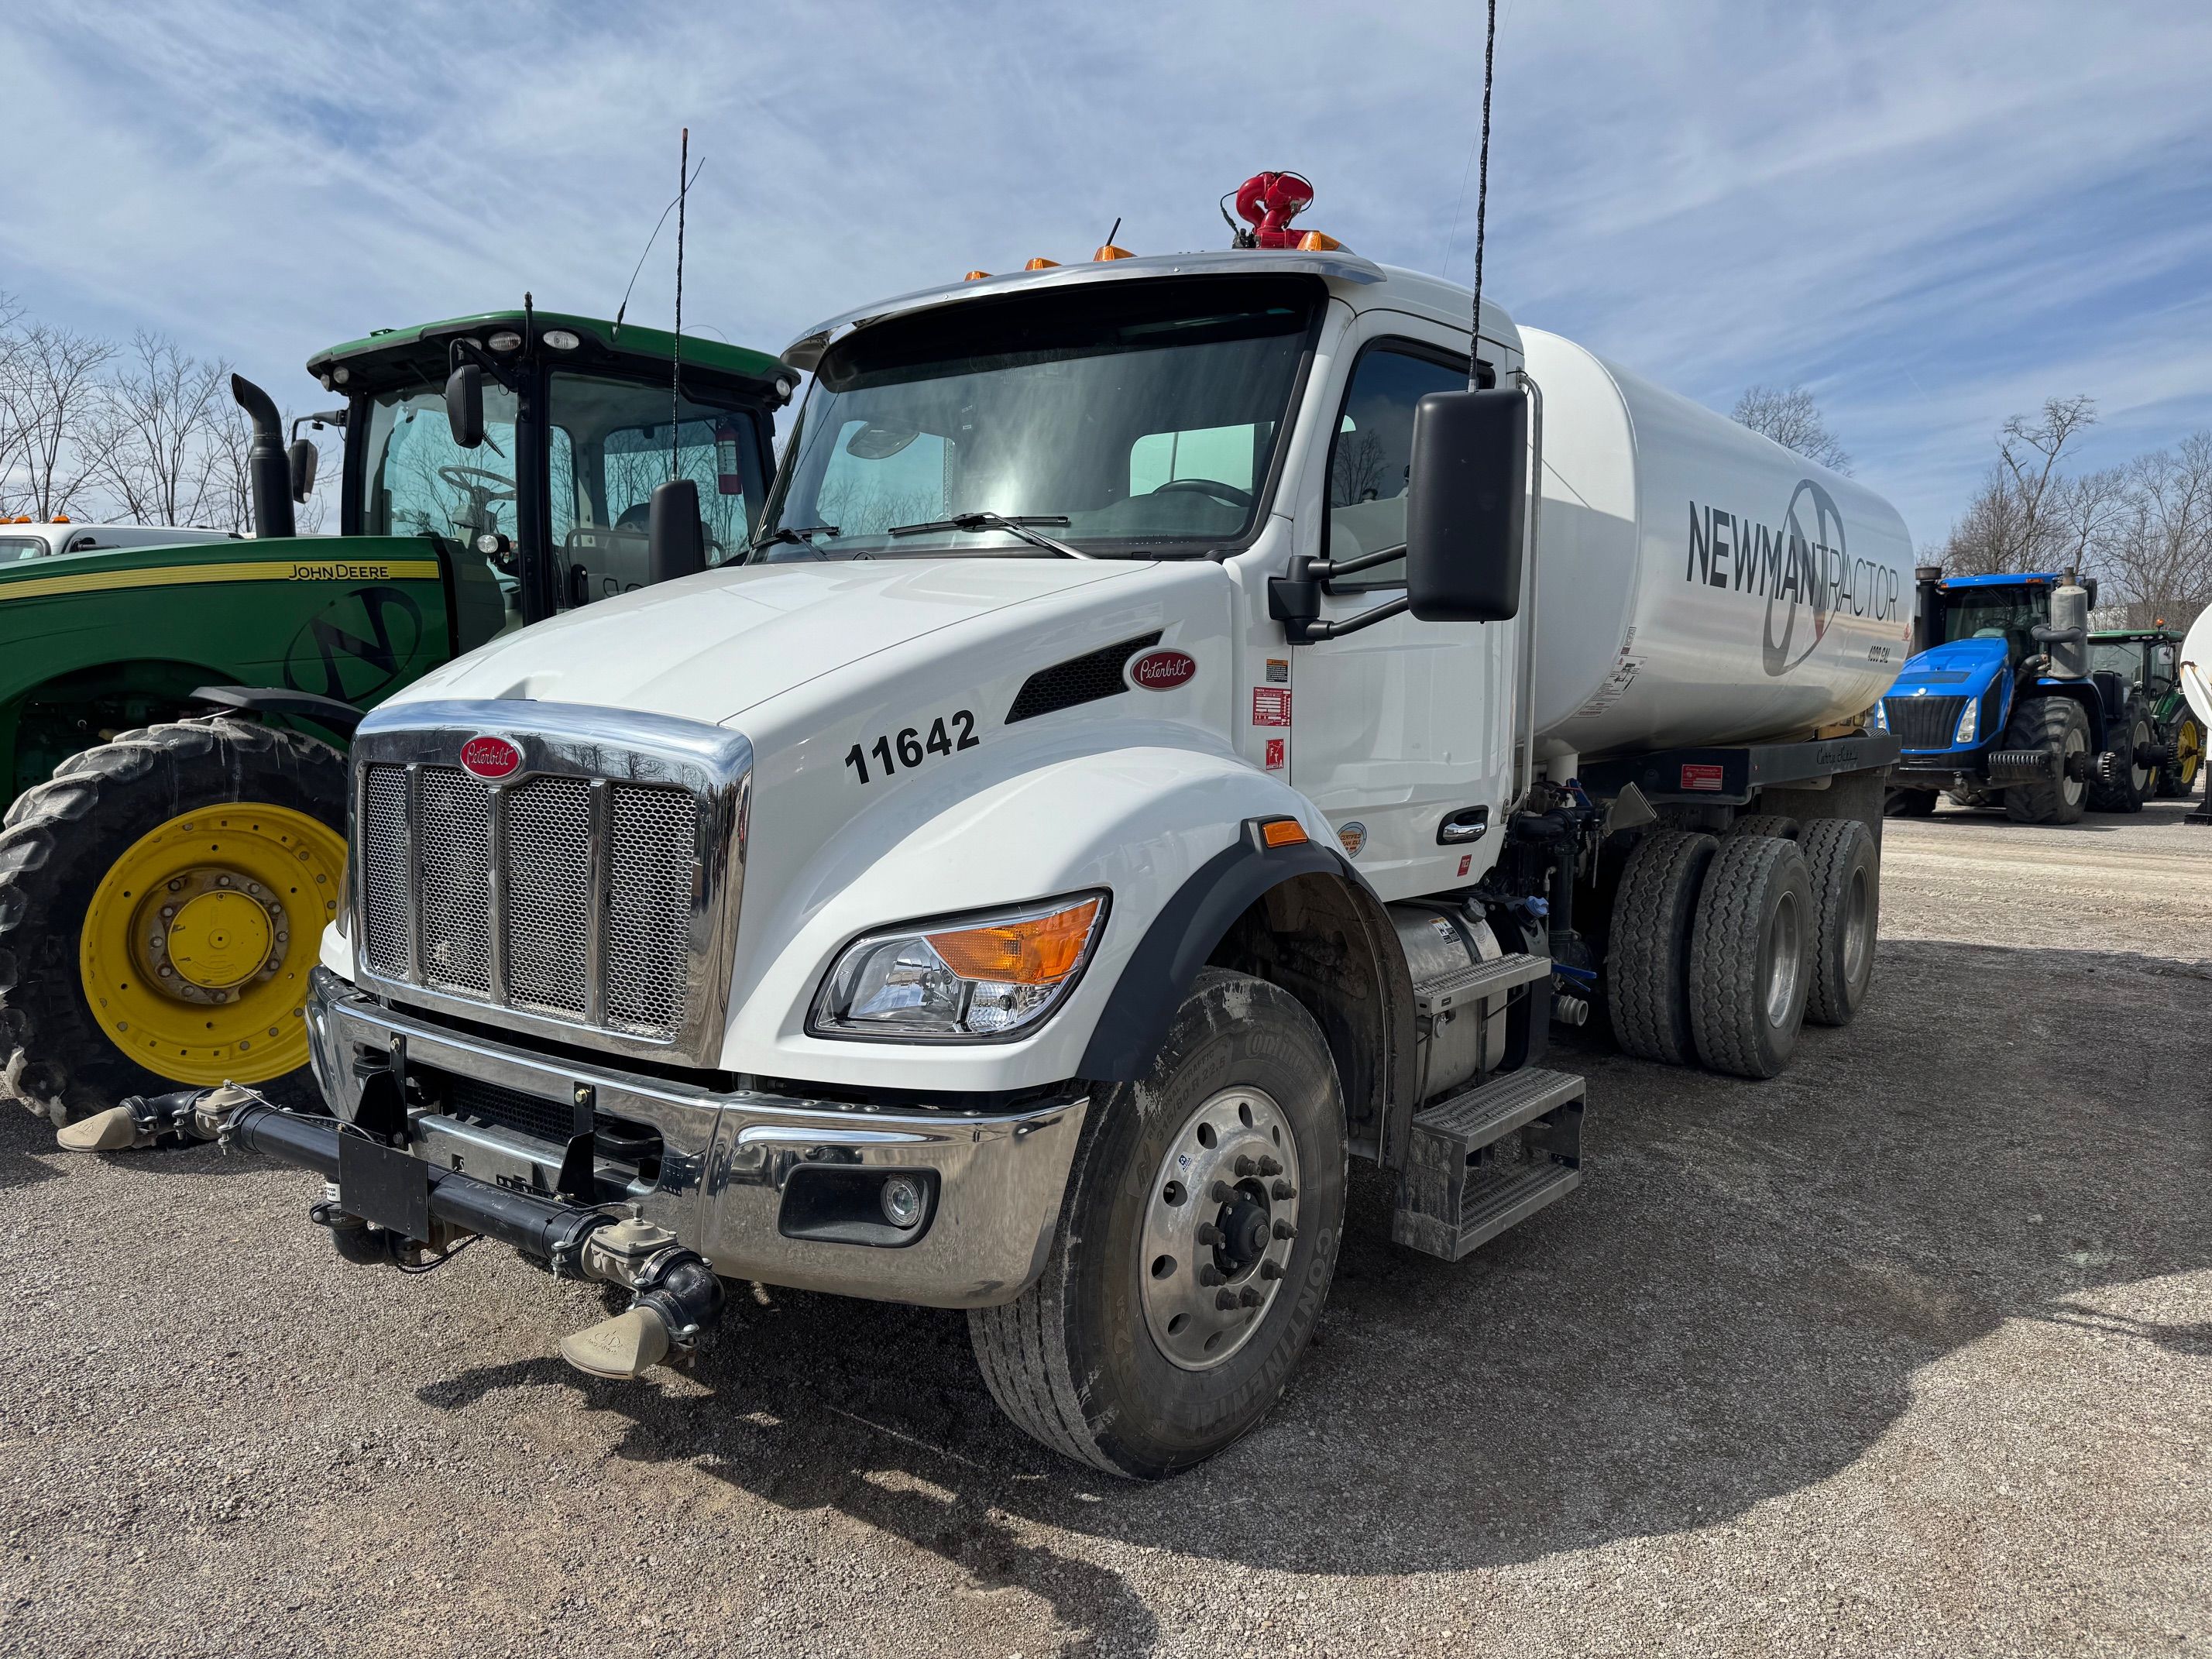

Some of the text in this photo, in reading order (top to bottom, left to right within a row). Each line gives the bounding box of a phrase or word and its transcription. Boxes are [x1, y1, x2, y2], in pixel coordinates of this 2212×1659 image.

[1140, 659, 1191, 682] Peterbilt
[465, 742, 514, 765] Peterbilt
[844, 709, 980, 785] 11642
[1182, 1049, 1214, 1084] TRAFFIC
